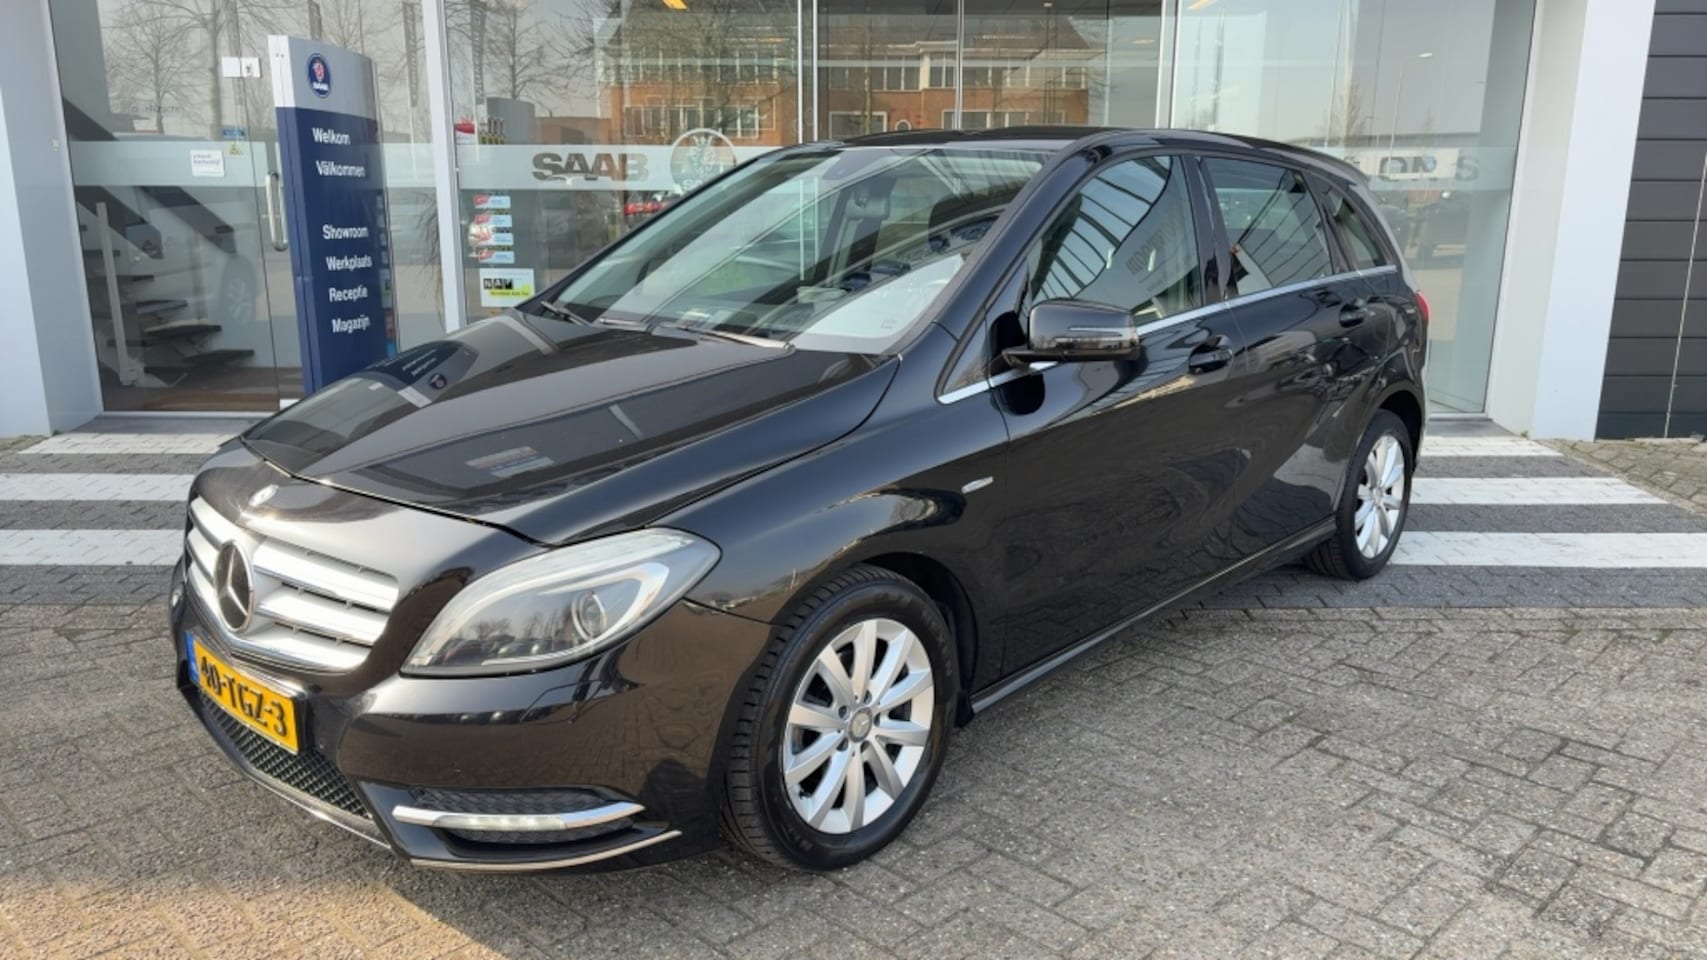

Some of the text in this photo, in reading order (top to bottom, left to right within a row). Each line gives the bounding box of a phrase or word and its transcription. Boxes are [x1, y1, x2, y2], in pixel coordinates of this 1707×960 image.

[311, 127, 351, 145] Welkom
[315, 160, 366, 177] Välkommen
[532, 152, 648, 182] SAAB
[322, 224, 369, 240] Showroom
[325, 254, 373, 271] Werkplaats
[328, 284, 368, 302] Receptie
[331, 314, 370, 334] Magazijn
[201, 656, 288, 738] 40-TGZ-3
